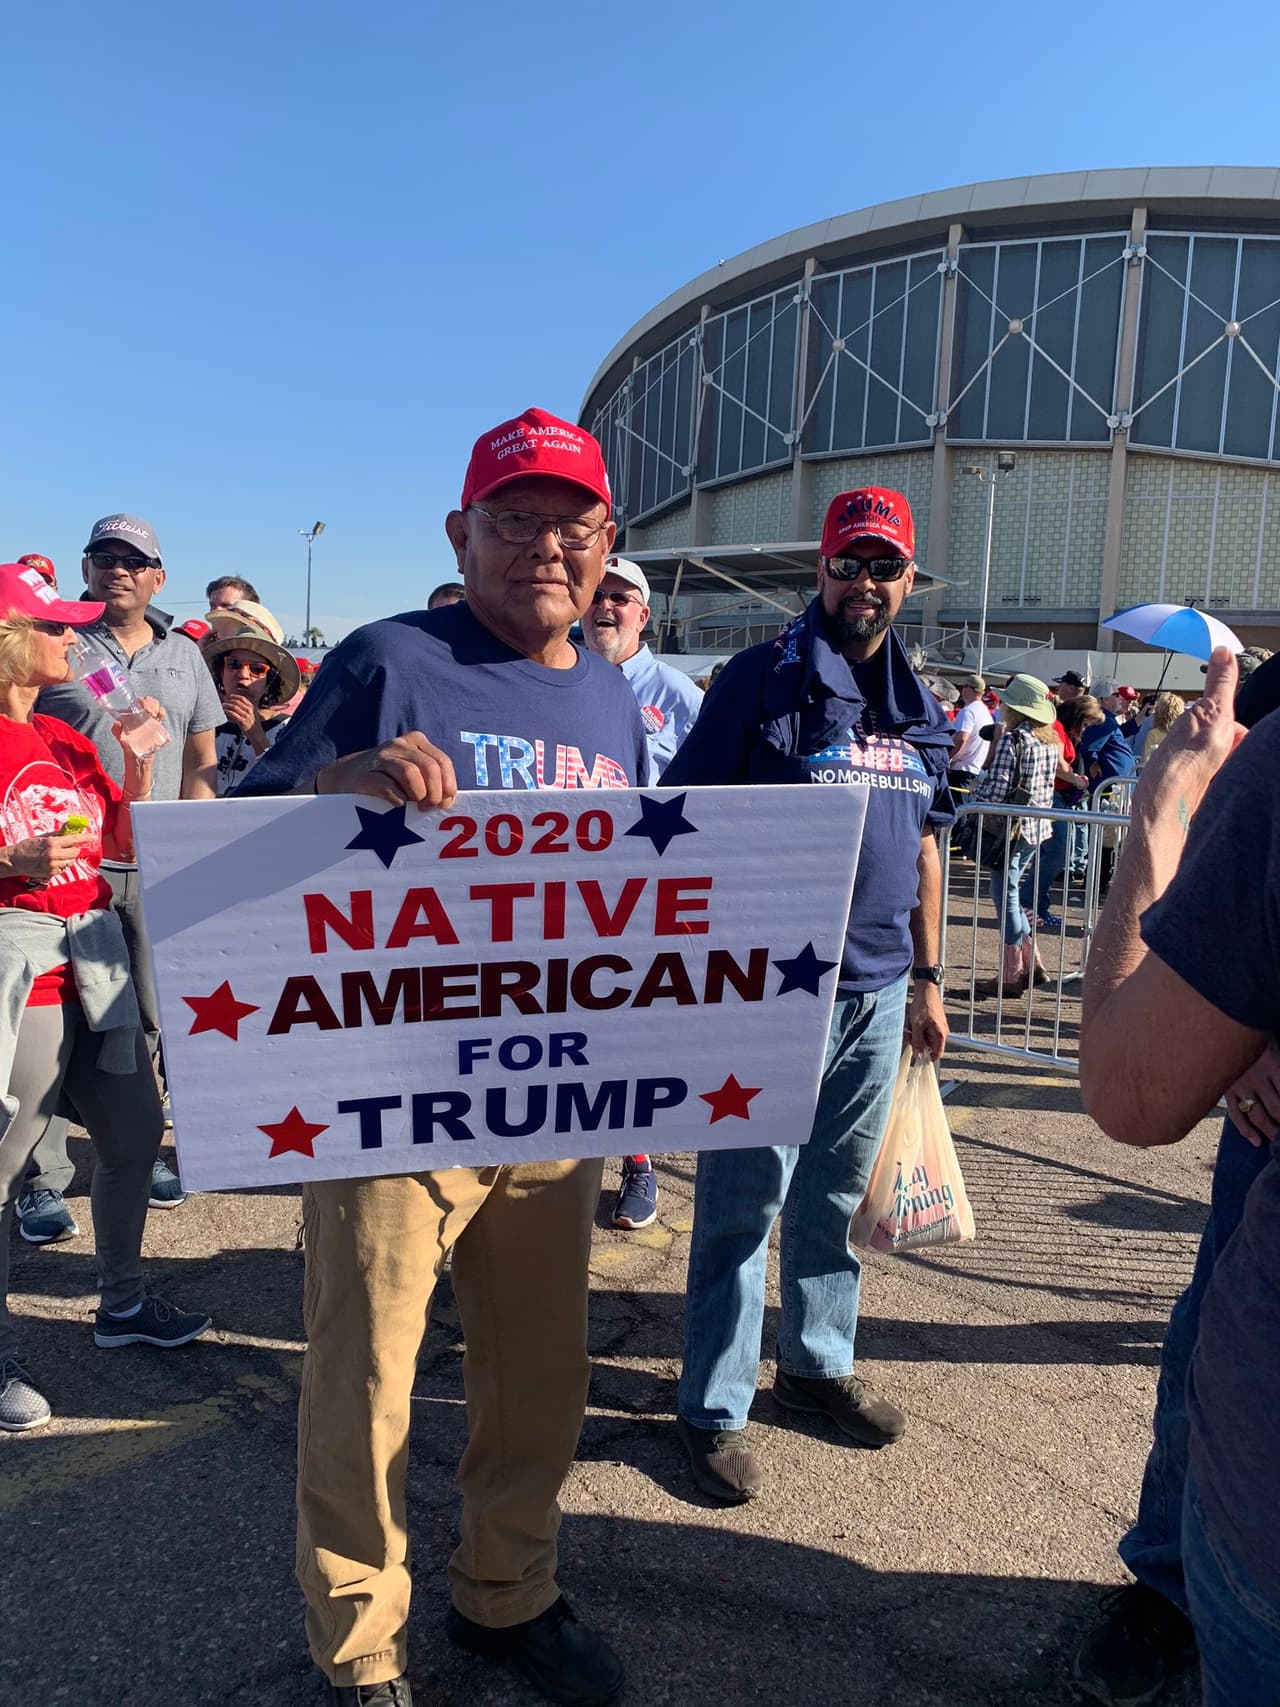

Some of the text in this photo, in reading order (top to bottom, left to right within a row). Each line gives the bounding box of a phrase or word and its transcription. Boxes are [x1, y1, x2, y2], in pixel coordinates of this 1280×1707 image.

[490, 426, 585, 450] MAKE AMERICA
[497, 439, 581, 459] GREAT AGAIN
[95, 519, 150, 538] Titleist
[838, 497, 901, 526] TRUMP
[460, 731, 629, 790] TRUMP
[810, 769, 836, 784] NO
[838, 769, 878, 788] MORE
[438, 809, 614, 859] 2020
[303, 876, 713, 954] NATIVE
[266, 948, 769, 1036] AMERICAN
[457, 1031, 590, 1075] FOR
[338, 1077, 688, 1149] TRUMP
